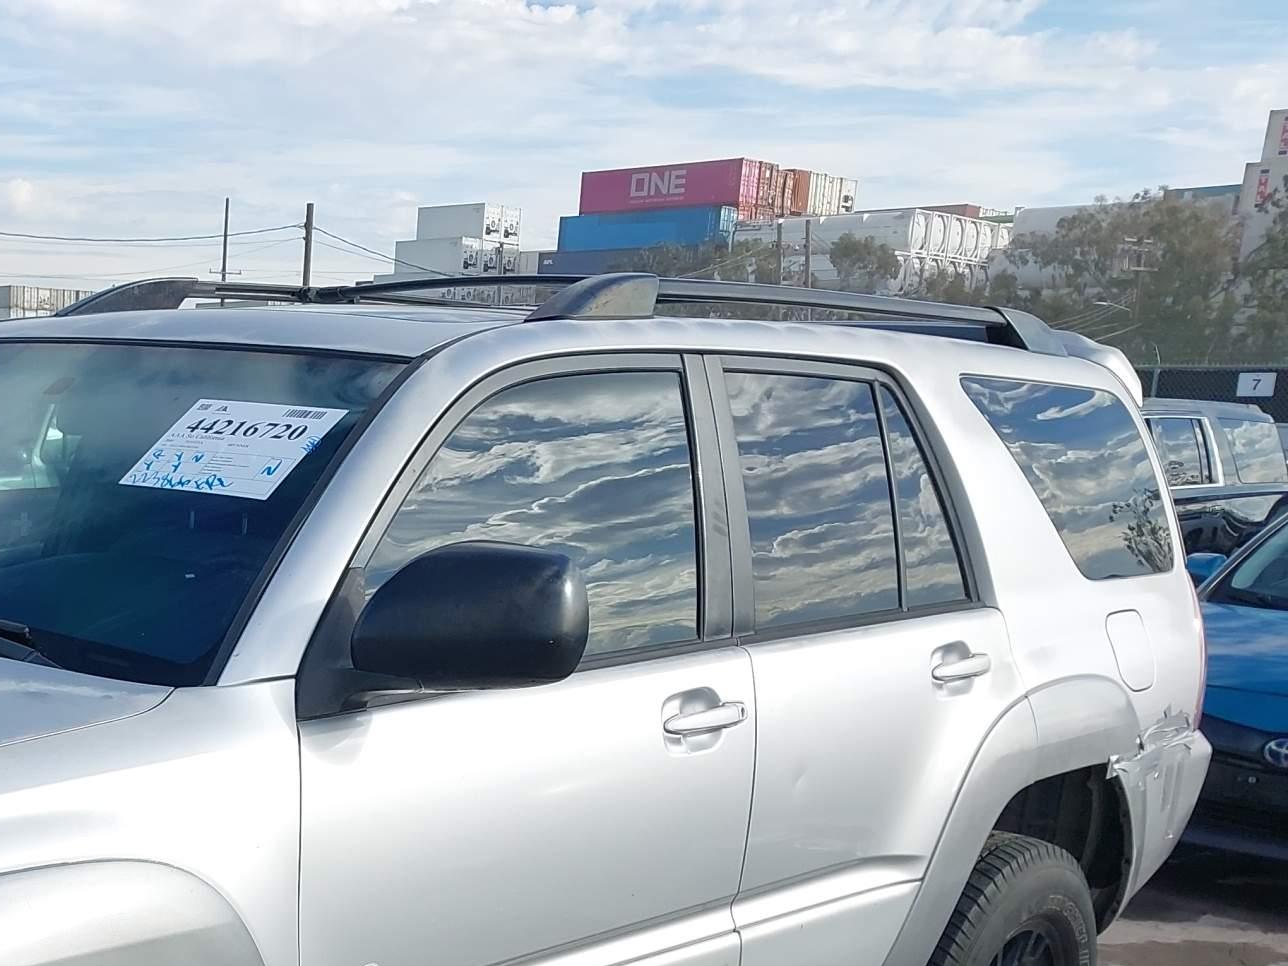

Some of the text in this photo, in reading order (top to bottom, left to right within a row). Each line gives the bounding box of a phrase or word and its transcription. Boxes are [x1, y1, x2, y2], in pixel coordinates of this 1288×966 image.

[630, 169, 688, 197] ONE
[1252, 378, 1262, 391] 7
[186, 417, 308, 441] 44216720
